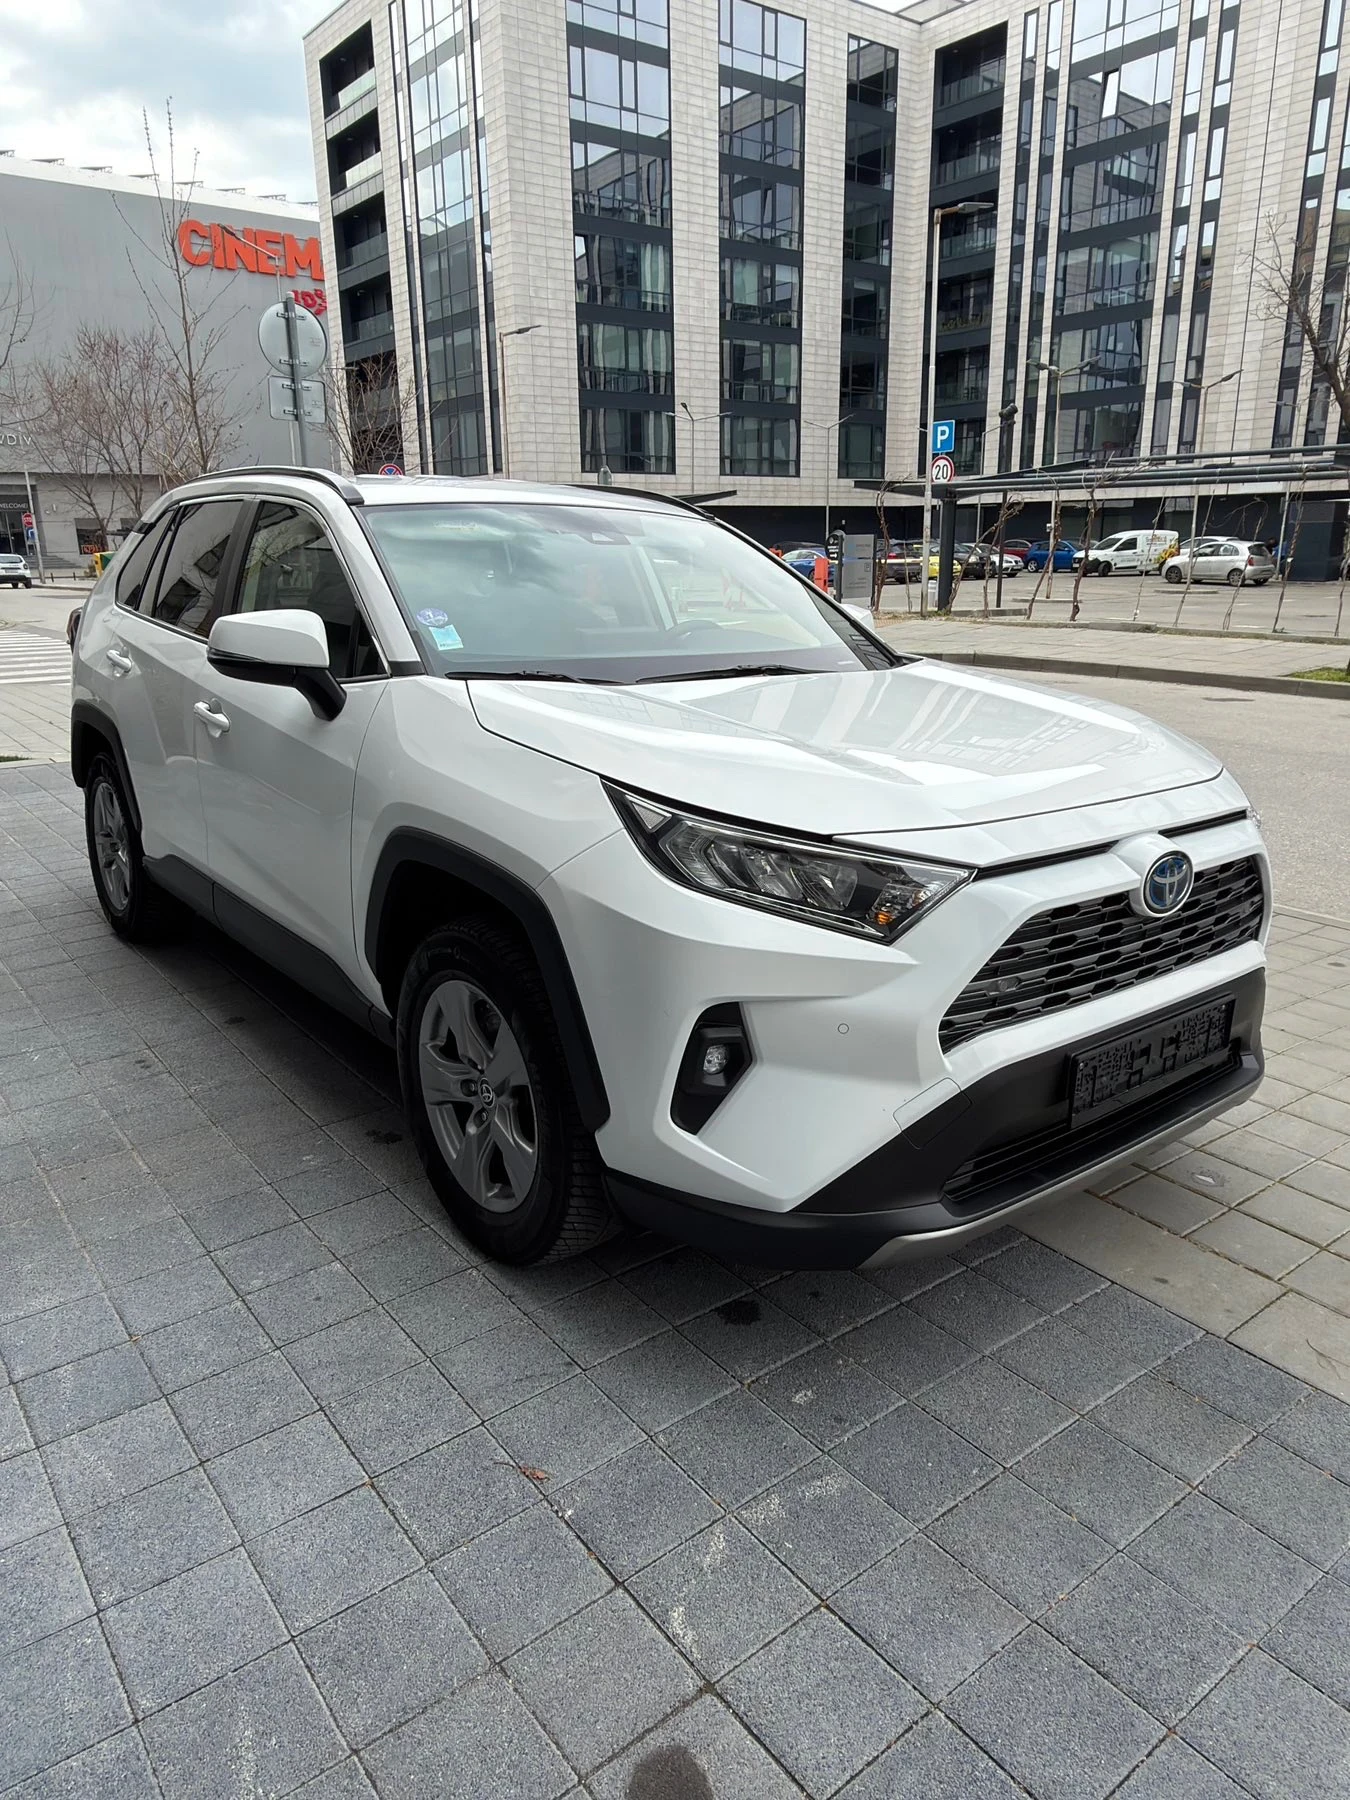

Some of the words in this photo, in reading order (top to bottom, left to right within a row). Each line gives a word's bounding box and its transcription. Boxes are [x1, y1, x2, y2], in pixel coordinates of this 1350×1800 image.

[178, 219, 326, 281] CINEM
[937, 425, 950, 449] P
[934, 464, 949, 480] 20
